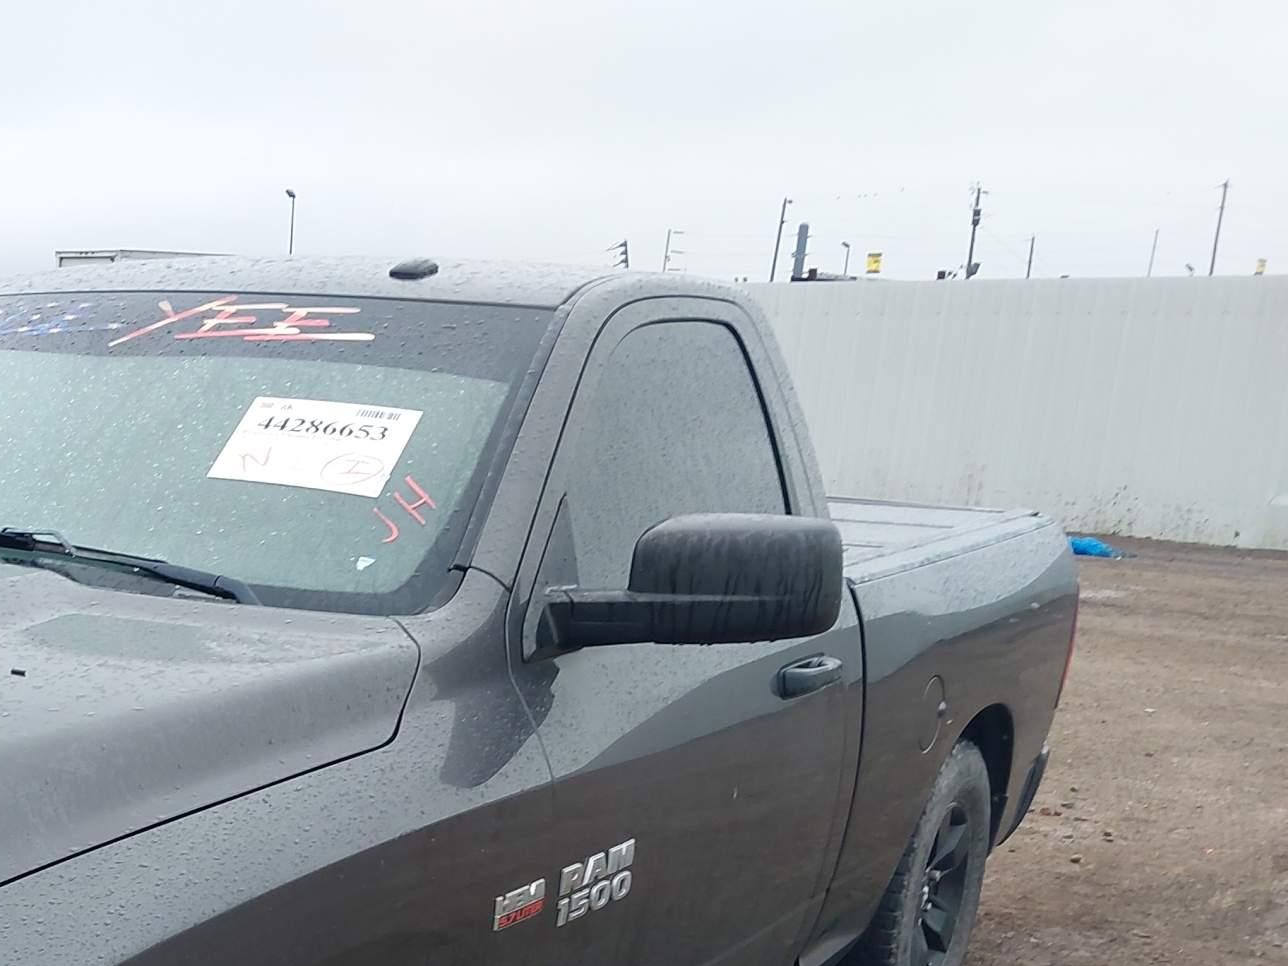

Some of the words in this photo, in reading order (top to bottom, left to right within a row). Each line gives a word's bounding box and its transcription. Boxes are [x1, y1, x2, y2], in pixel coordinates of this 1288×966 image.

[257, 415, 389, 442] 44286653
[559, 838, 636, 897] RAM
[555, 869, 633, 928] 1500
